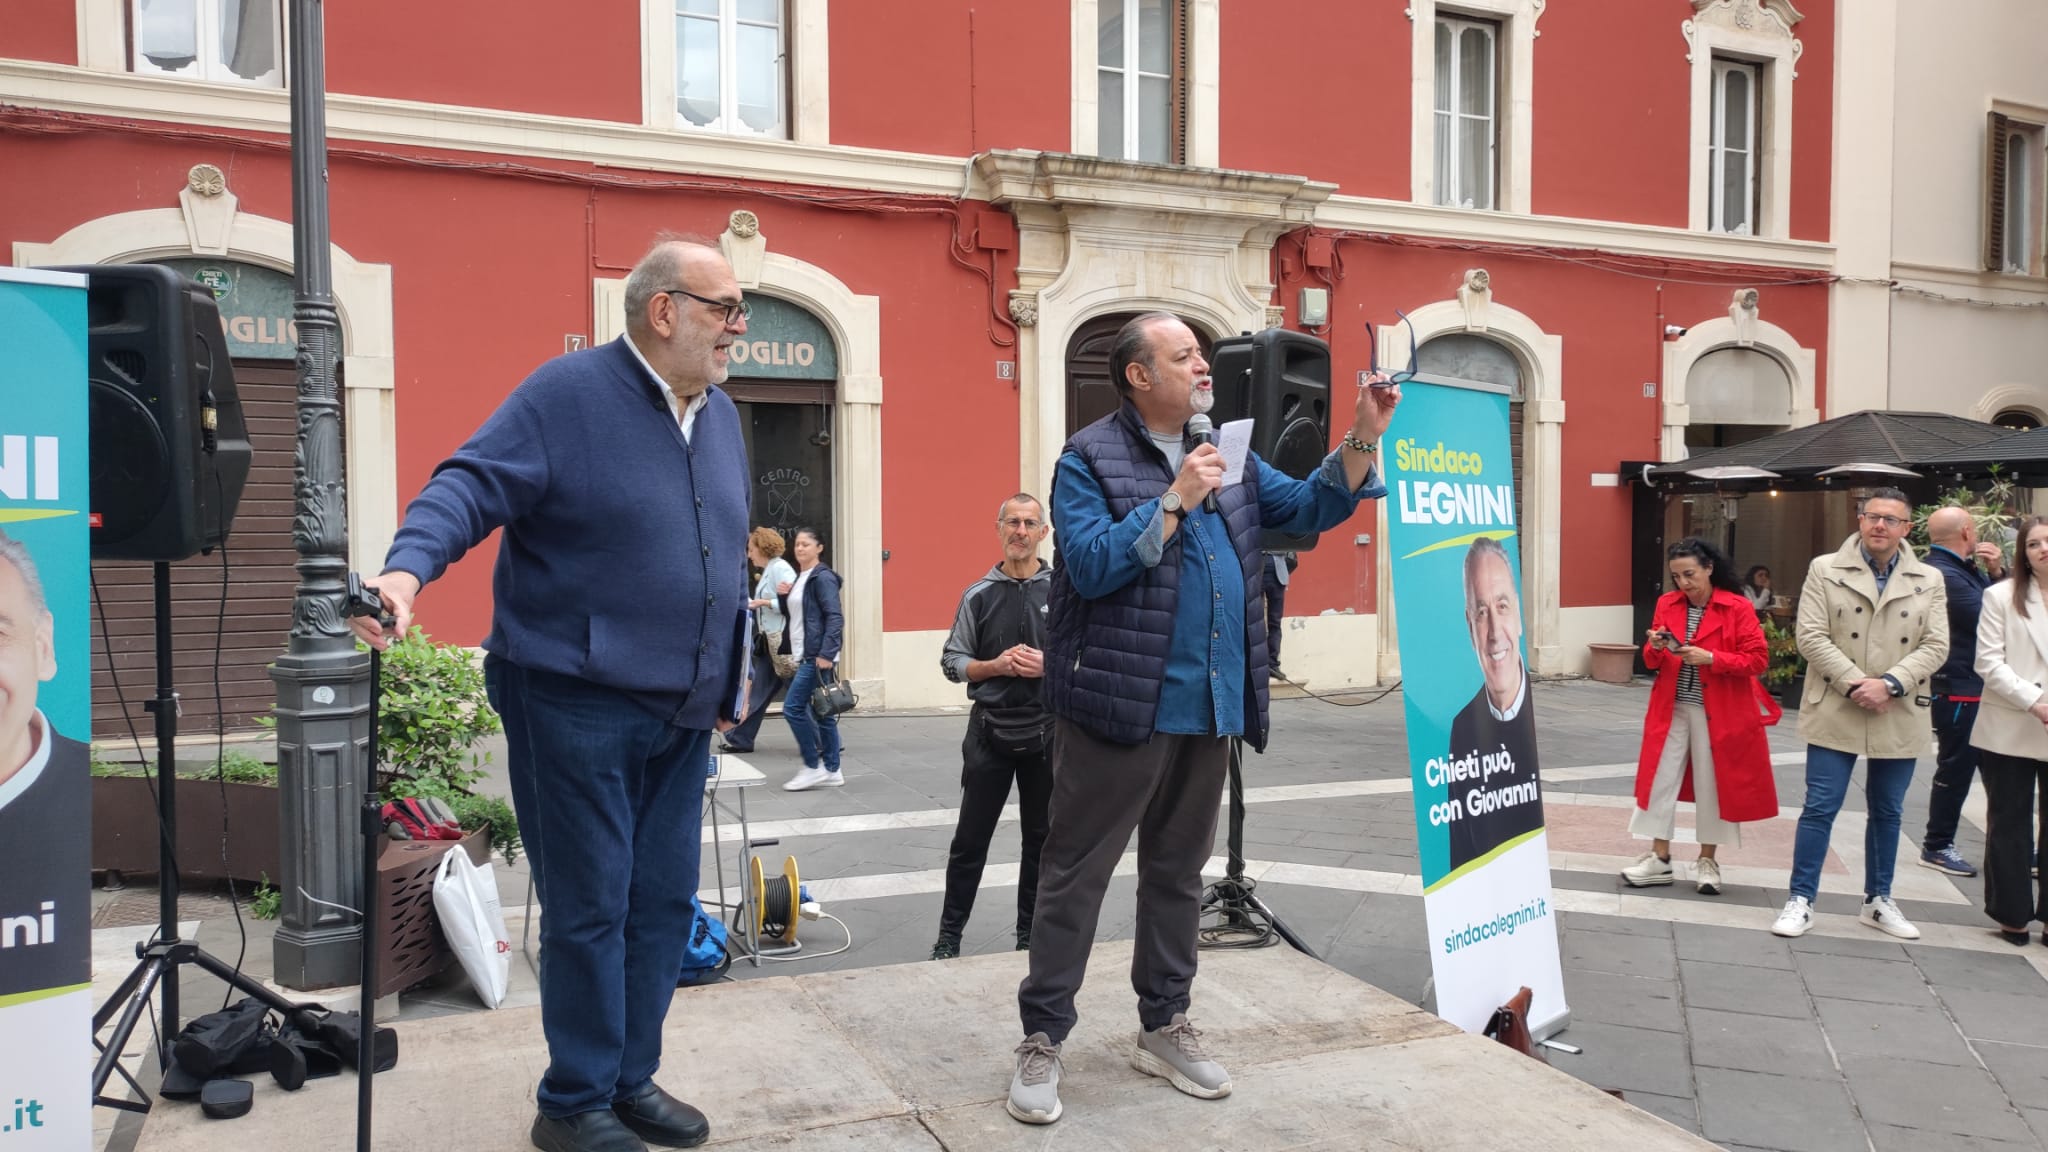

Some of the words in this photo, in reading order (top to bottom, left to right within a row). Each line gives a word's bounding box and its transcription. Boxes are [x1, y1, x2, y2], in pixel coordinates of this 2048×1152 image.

[572, 338, 580, 351] 7
[1003, 363, 1009, 377] 8
[1395, 438, 1482, 475] Sindaco
[760, 468, 810, 487] CENTRO
[1398, 480, 1513, 525] LEGNINI
[1425, 749, 1480, 787] Chieti
[1482, 743, 1515, 783] può,
[1429, 799, 1463, 826] con
[1466, 773, 1538, 816] Giovanni
[1444, 897, 1546, 954] sindacolegnini.it
[3, 1098, 44, 1132] .it
